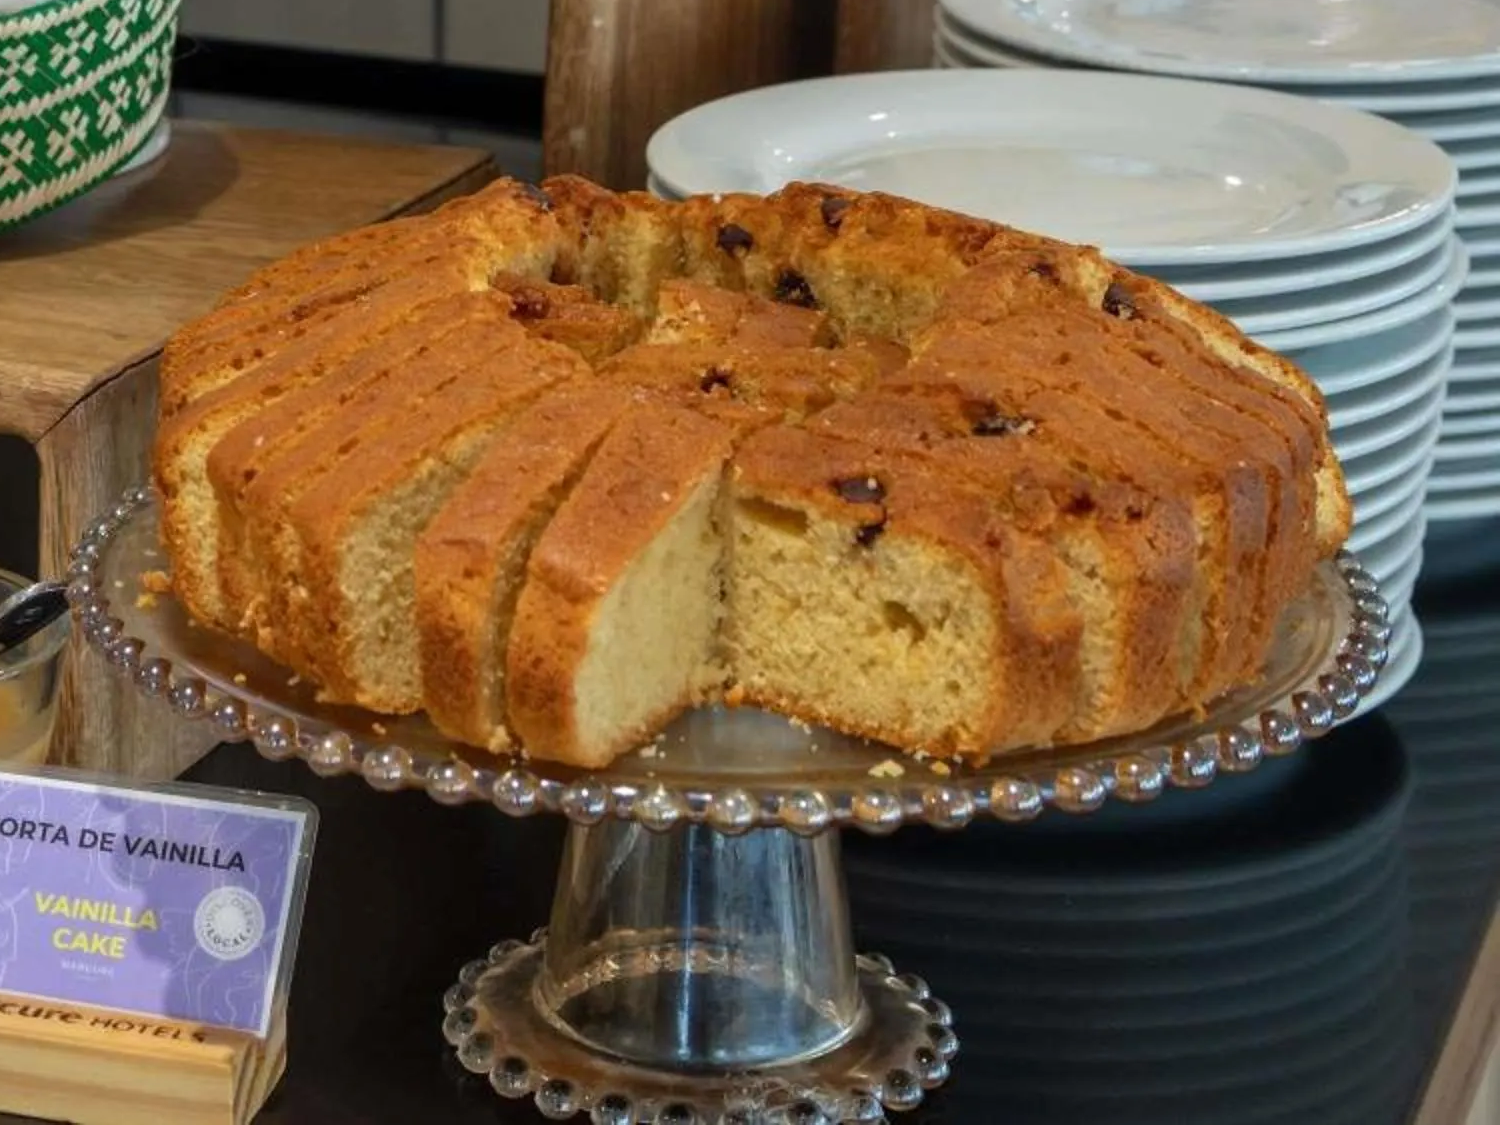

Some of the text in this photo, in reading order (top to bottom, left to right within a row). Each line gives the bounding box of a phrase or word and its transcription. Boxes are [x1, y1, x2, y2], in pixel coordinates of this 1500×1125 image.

[78, 829, 115, 852] DE
[123, 836, 246, 873] VAINILLA
[34, 891, 161, 932] VAINILLA
[52, 928, 127, 958] CAKE
[89, 1017, 207, 1044] HOTELS
